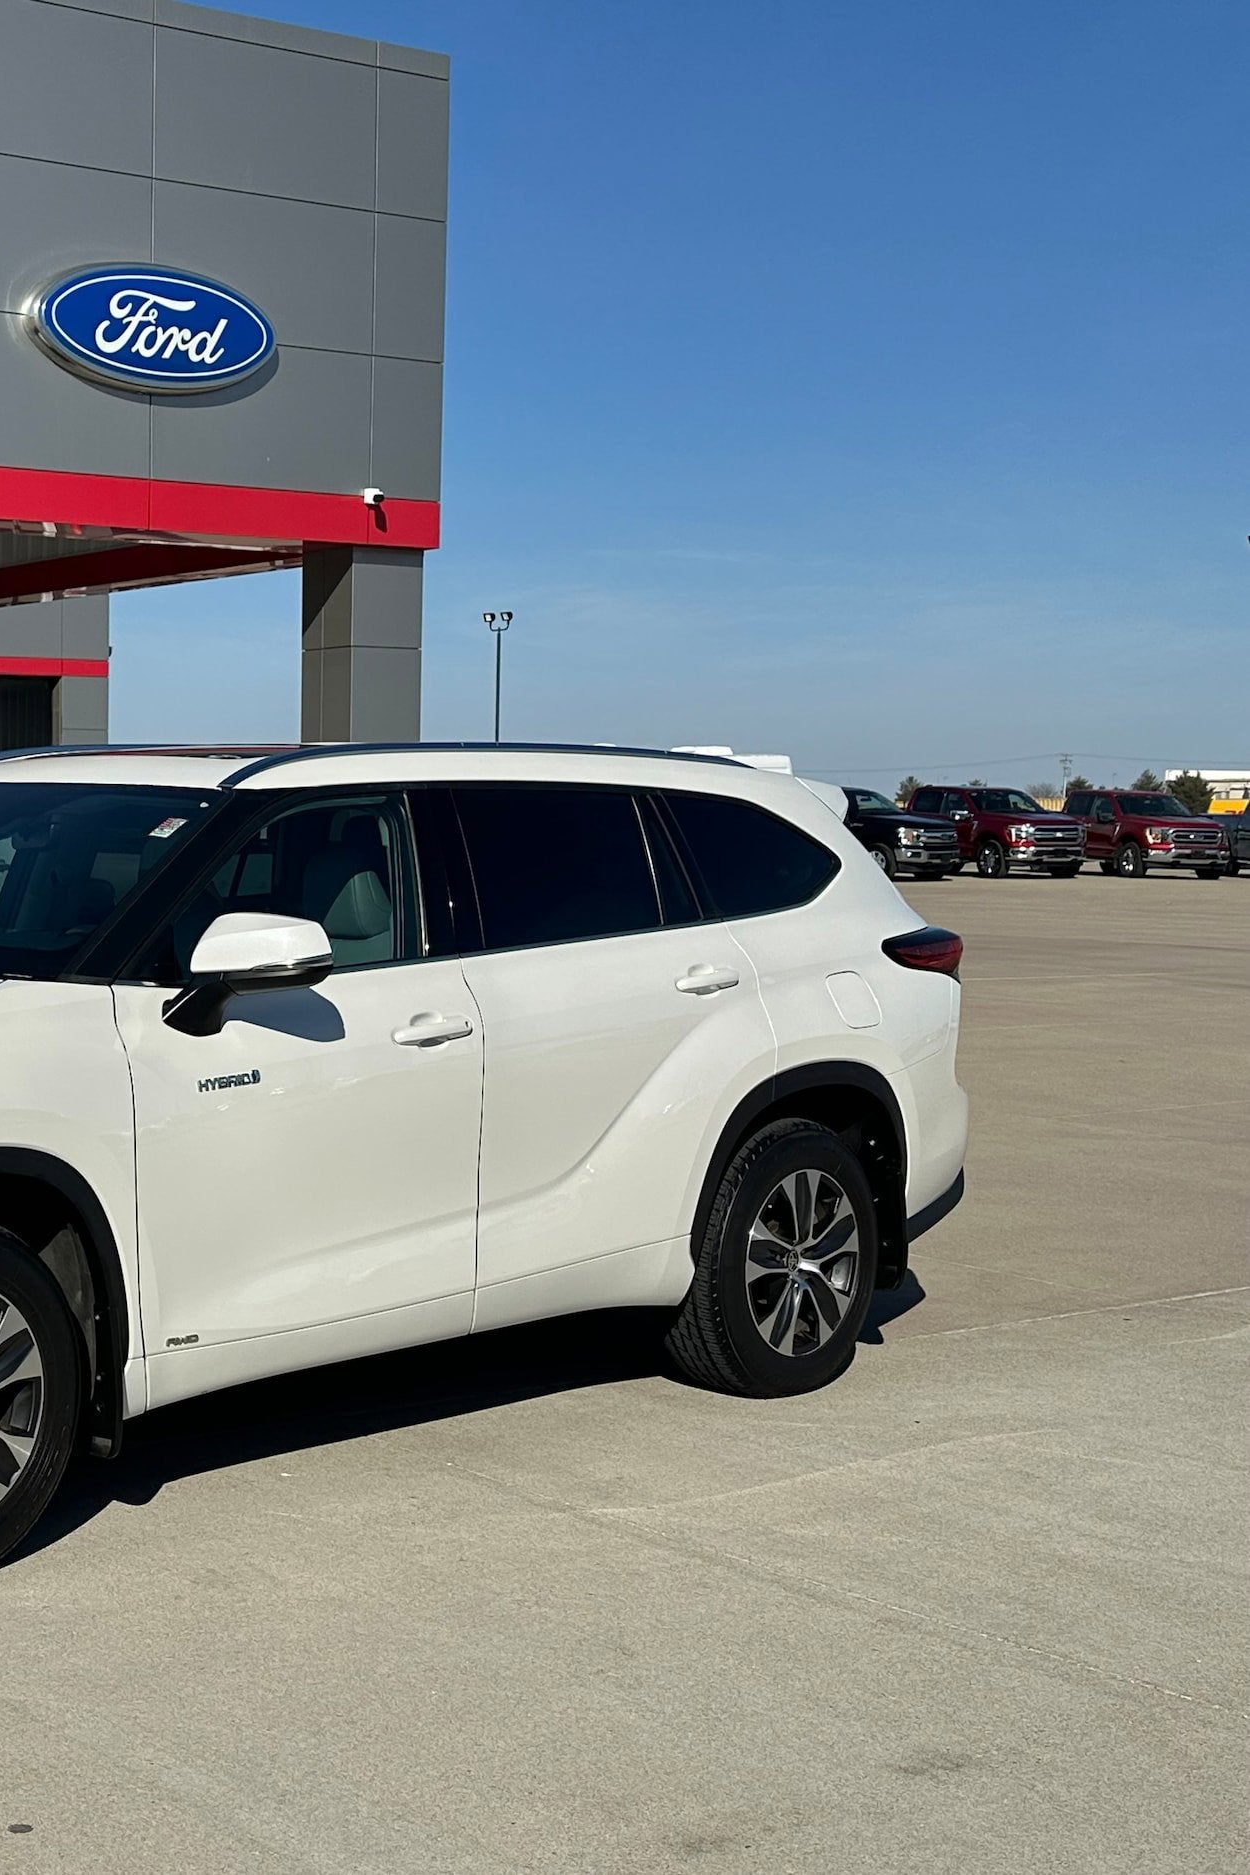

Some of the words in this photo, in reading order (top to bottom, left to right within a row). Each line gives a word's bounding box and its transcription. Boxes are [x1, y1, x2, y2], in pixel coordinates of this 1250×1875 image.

[95, 289, 227, 364] Ford
[198, 1073, 252, 1092] HYBRID
[166, 1334, 199, 1347] AWD
